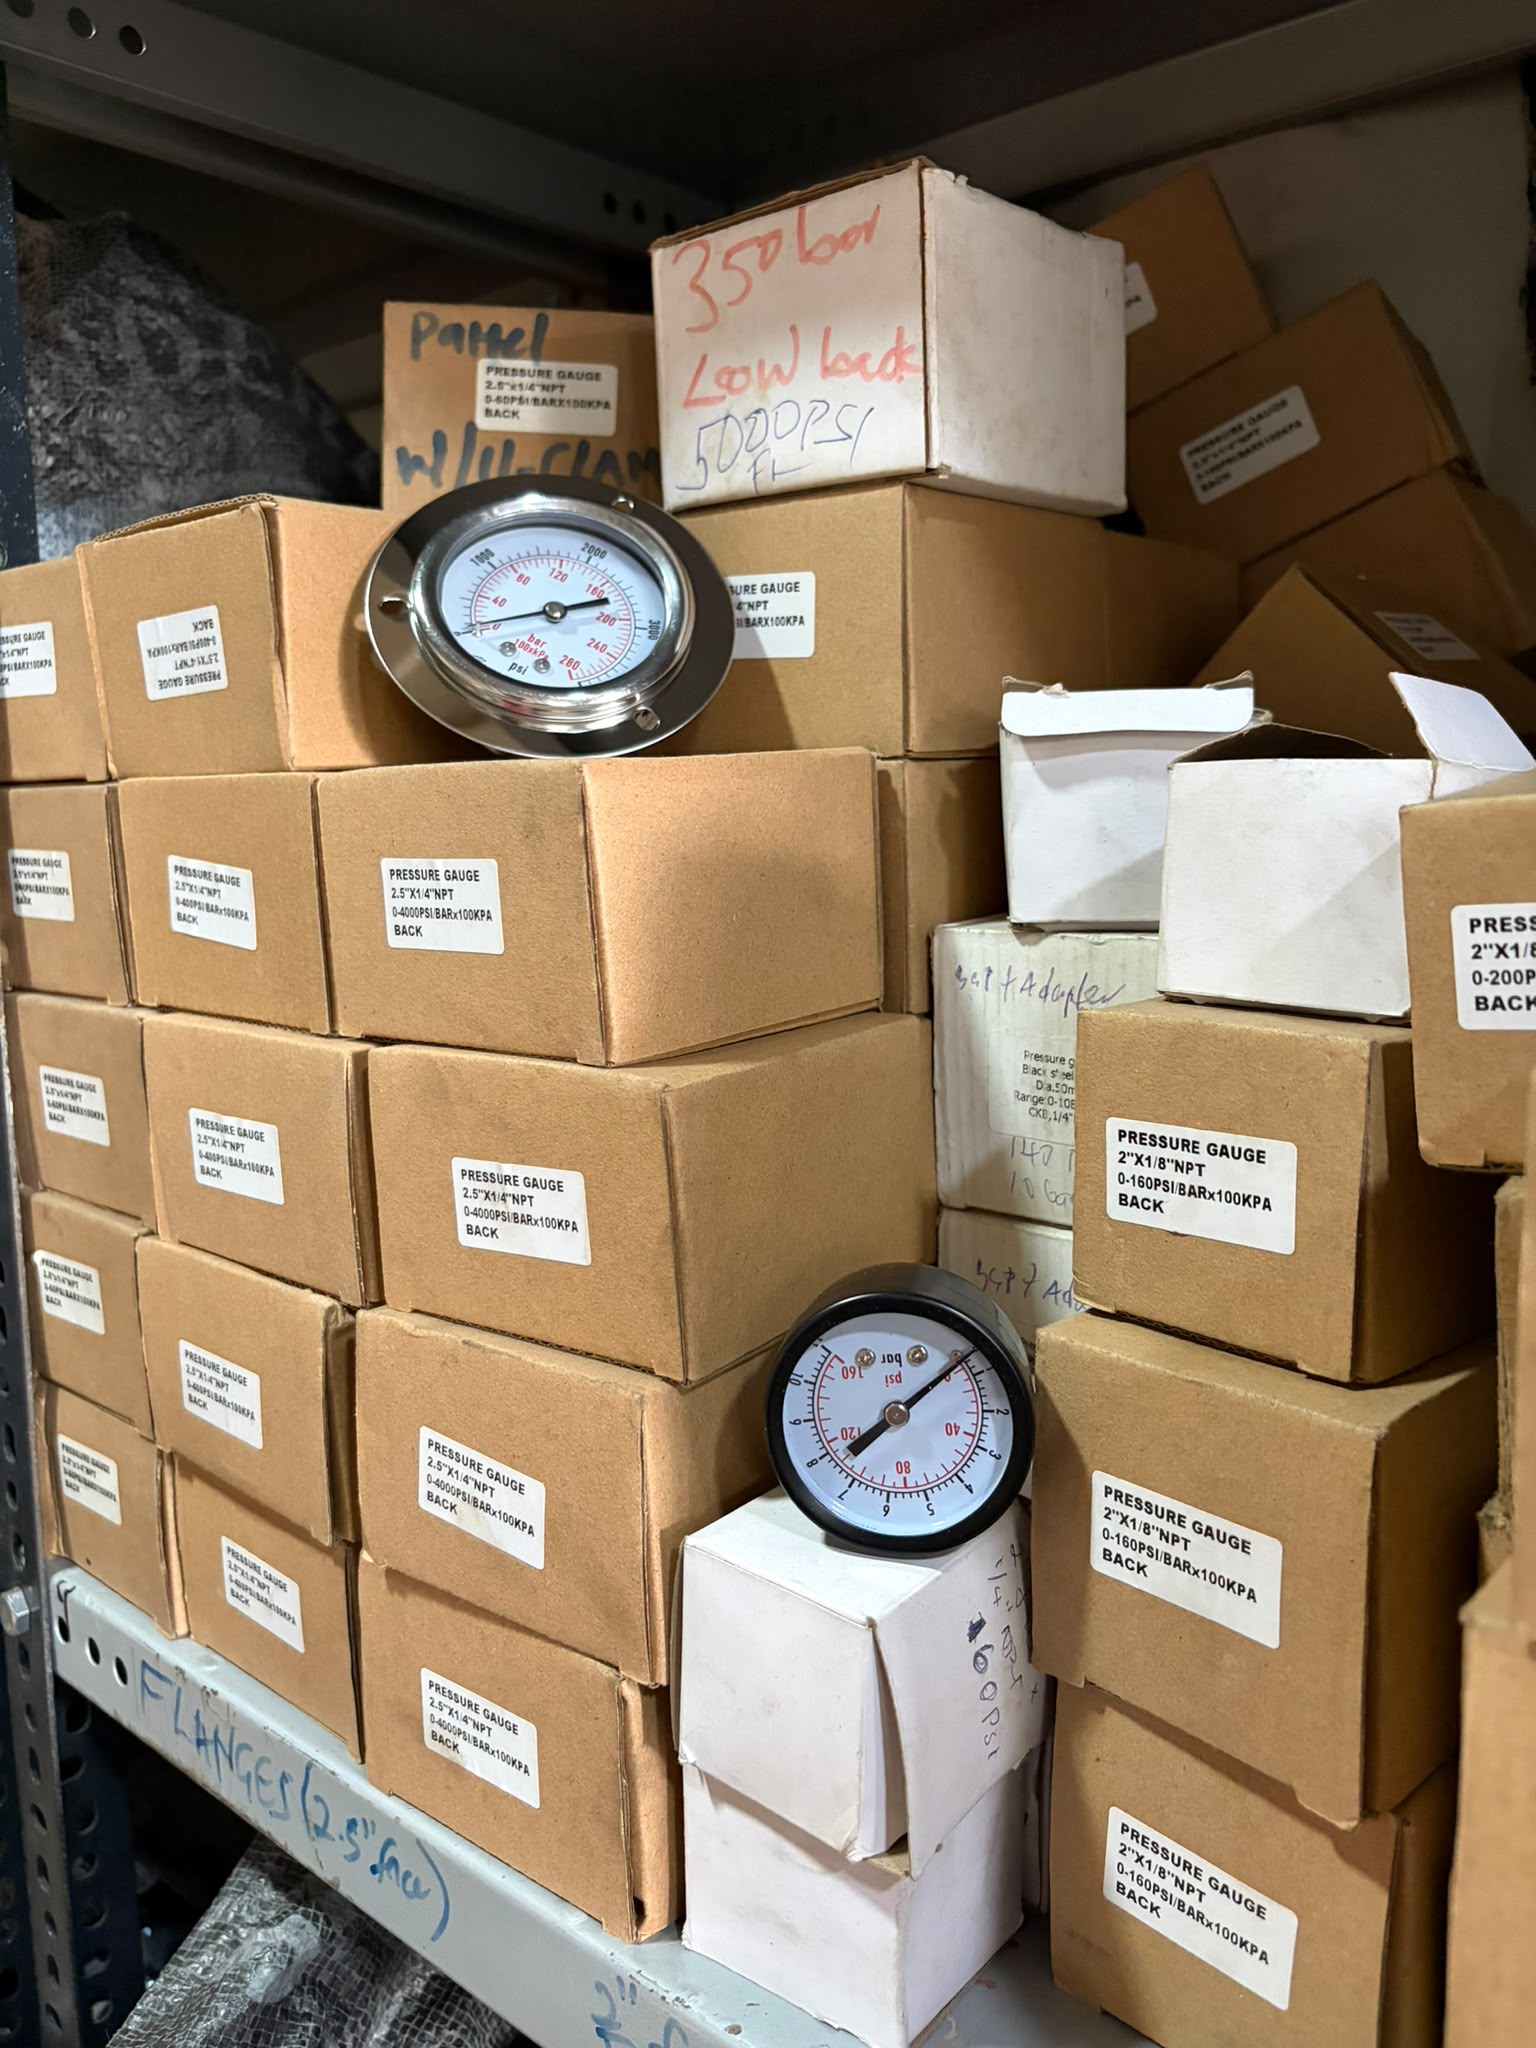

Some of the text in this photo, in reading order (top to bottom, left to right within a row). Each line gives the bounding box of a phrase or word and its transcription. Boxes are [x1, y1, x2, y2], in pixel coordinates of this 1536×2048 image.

[672, 228, 783, 333] 350
[486, 366, 602, 382] PRESSURE GAUGE
[485, 408, 520, 420] BACK
[470, 548, 496, 568] 1000
[580, 542, 608, 560] 2000
[516, 572, 530, 586] 80
[549, 567, 569, 583] 120
[585, 583, 605, 599] 160
[760, 581, 801, 594] GAUGE
[492, 595, 507, 608] 40
[192, 618, 214, 632] BACK
[595, 611, 616, 627] 200
[648, 619, 661, 641] 3000
[527, 633, 547, 648] bar
[586, 637, 608, 654] 240
[507, 662, 530, 675] psi
[559, 654, 580, 671] 280
[158, 670, 221, 690] PRESSURE GAUGE
[174, 865, 241, 888] PRESSURE GAUGE
[389, 868, 481, 882] PRESSURE GAUGE
[391, 887, 454, 901] 2.5"X1/4"NPT
[176, 912, 199, 926] BACK
[394, 924, 423, 937] BACK
[1023, 1050, 1066, 1066] Pressure
[196, 1117, 265, 1143] PRESSURE GAUGE
[1118, 1129, 1267, 1165] PRESSURE GAUGE
[200, 1164, 223, 1180] BACK
[1118, 1151, 1206, 1177] 2"X1/8"NPT
[460, 1168, 564, 1193] PRESSURE GAUGE
[463, 1187, 535, 1207] 2.5"X1/4"NPT
[1117, 1172, 1272, 1212] 0-160PSI/BARx100KPA
[1118, 1193, 1165, 1214] BACK
[466, 1224, 499, 1240] BACK
[185, 1349, 248, 1387] PRESSURE GAUGE
[881, 1353, 902, 1367] bar
[789, 1373, 804, 1386] 10
[842, 1365, 864, 1379] 160
[885, 1371, 902, 1387] psi
[188, 1393, 208, 1411] BACK
[841, 1426, 861, 1440] 120
[945, 1422, 961, 1436] 40
[806, 1458, 819, 1469] 8
[988, 1449, 1002, 1462] 3
[427, 1438, 526, 1496] PRESSURE GAUGE
[895, 1460, 911, 1475] 80
[427, 1456, 496, 1498] 2.5"X1/4"NPT
[837, 1489, 849, 1501] 7
[963, 1483, 974, 1495] 4
[427, 1490, 458, 1516] BACK
[883, 1504, 890, 1517] 6
[926, 1504, 935, 1517] 5
[1104, 1484, 1252, 1556] PRESSURE GAUGE
[1103, 1506, 1192, 1552] 2"X1/8"NPT
[227, 1546, 288, 1593] PRESSURE GAUGE
[1102, 1547, 1149, 1578] BACK
[1102, 1527, 1258, 1604] 0-160PSI/BARx100KPA
[230, 1588, 251, 1608] BACK
[428, 1680, 519, 1736] PRESSURE GAUGE
[429, 1697, 493, 1737] 2.5"X1/4"NPT
[431, 1730, 461, 1755] BACK
[1118, 1842, 1207, 1904] 2"X1/8"NPT
[1120, 1822, 1268, 1920] PRESSURE GAUGE
[1116, 1880, 1162, 1919] BACK
[1116, 1862, 1270, 1966] 0-160PSI/BARx100KPA
